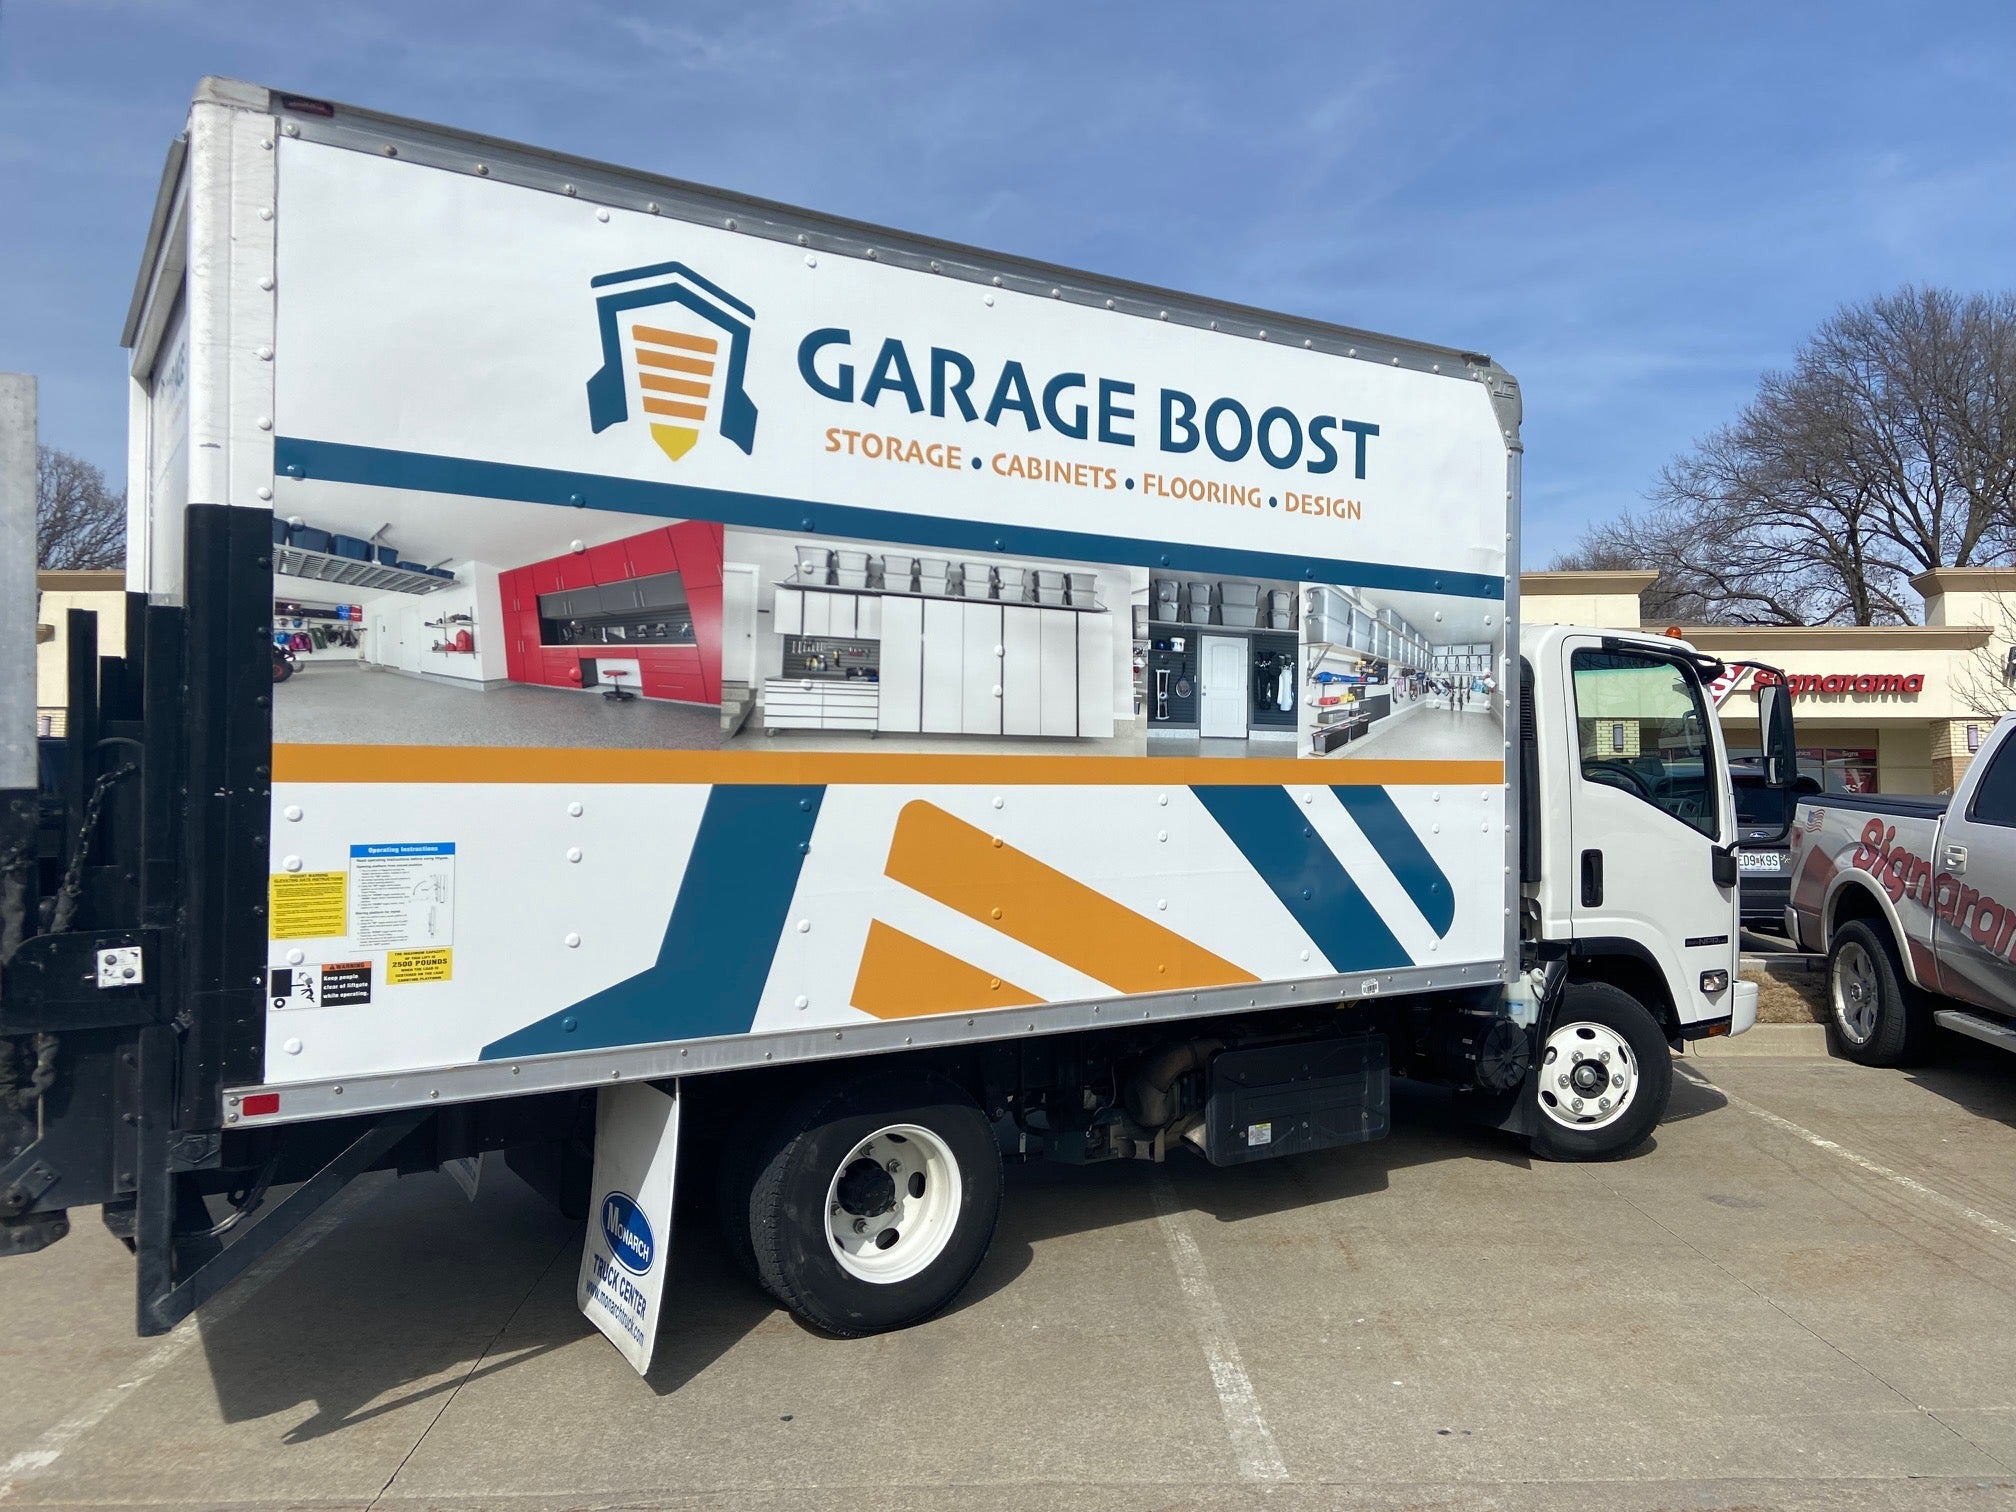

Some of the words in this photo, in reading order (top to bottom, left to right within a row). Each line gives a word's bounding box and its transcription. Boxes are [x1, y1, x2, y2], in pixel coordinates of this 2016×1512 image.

[797, 327, 1136, 447] GARAGE
[1158, 388, 1380, 480] BOOST
[824, 427, 962, 470] STORAGE
[991, 452, 1117, 490] CABINETS
[1143, 473, 1262, 508] FLOORING
[1285, 491, 1361, 520] DESIGN
[1751, 669, 1925, 696] Signarama
[415, 958, 448, 966] POUNDS
[606, 1202, 650, 1263] MONARCH
[586, 1280, 645, 1347] www.monarchtruck.com
[593, 1254, 619, 1293] TRUCK
[619, 1276, 648, 1321] CENTER
